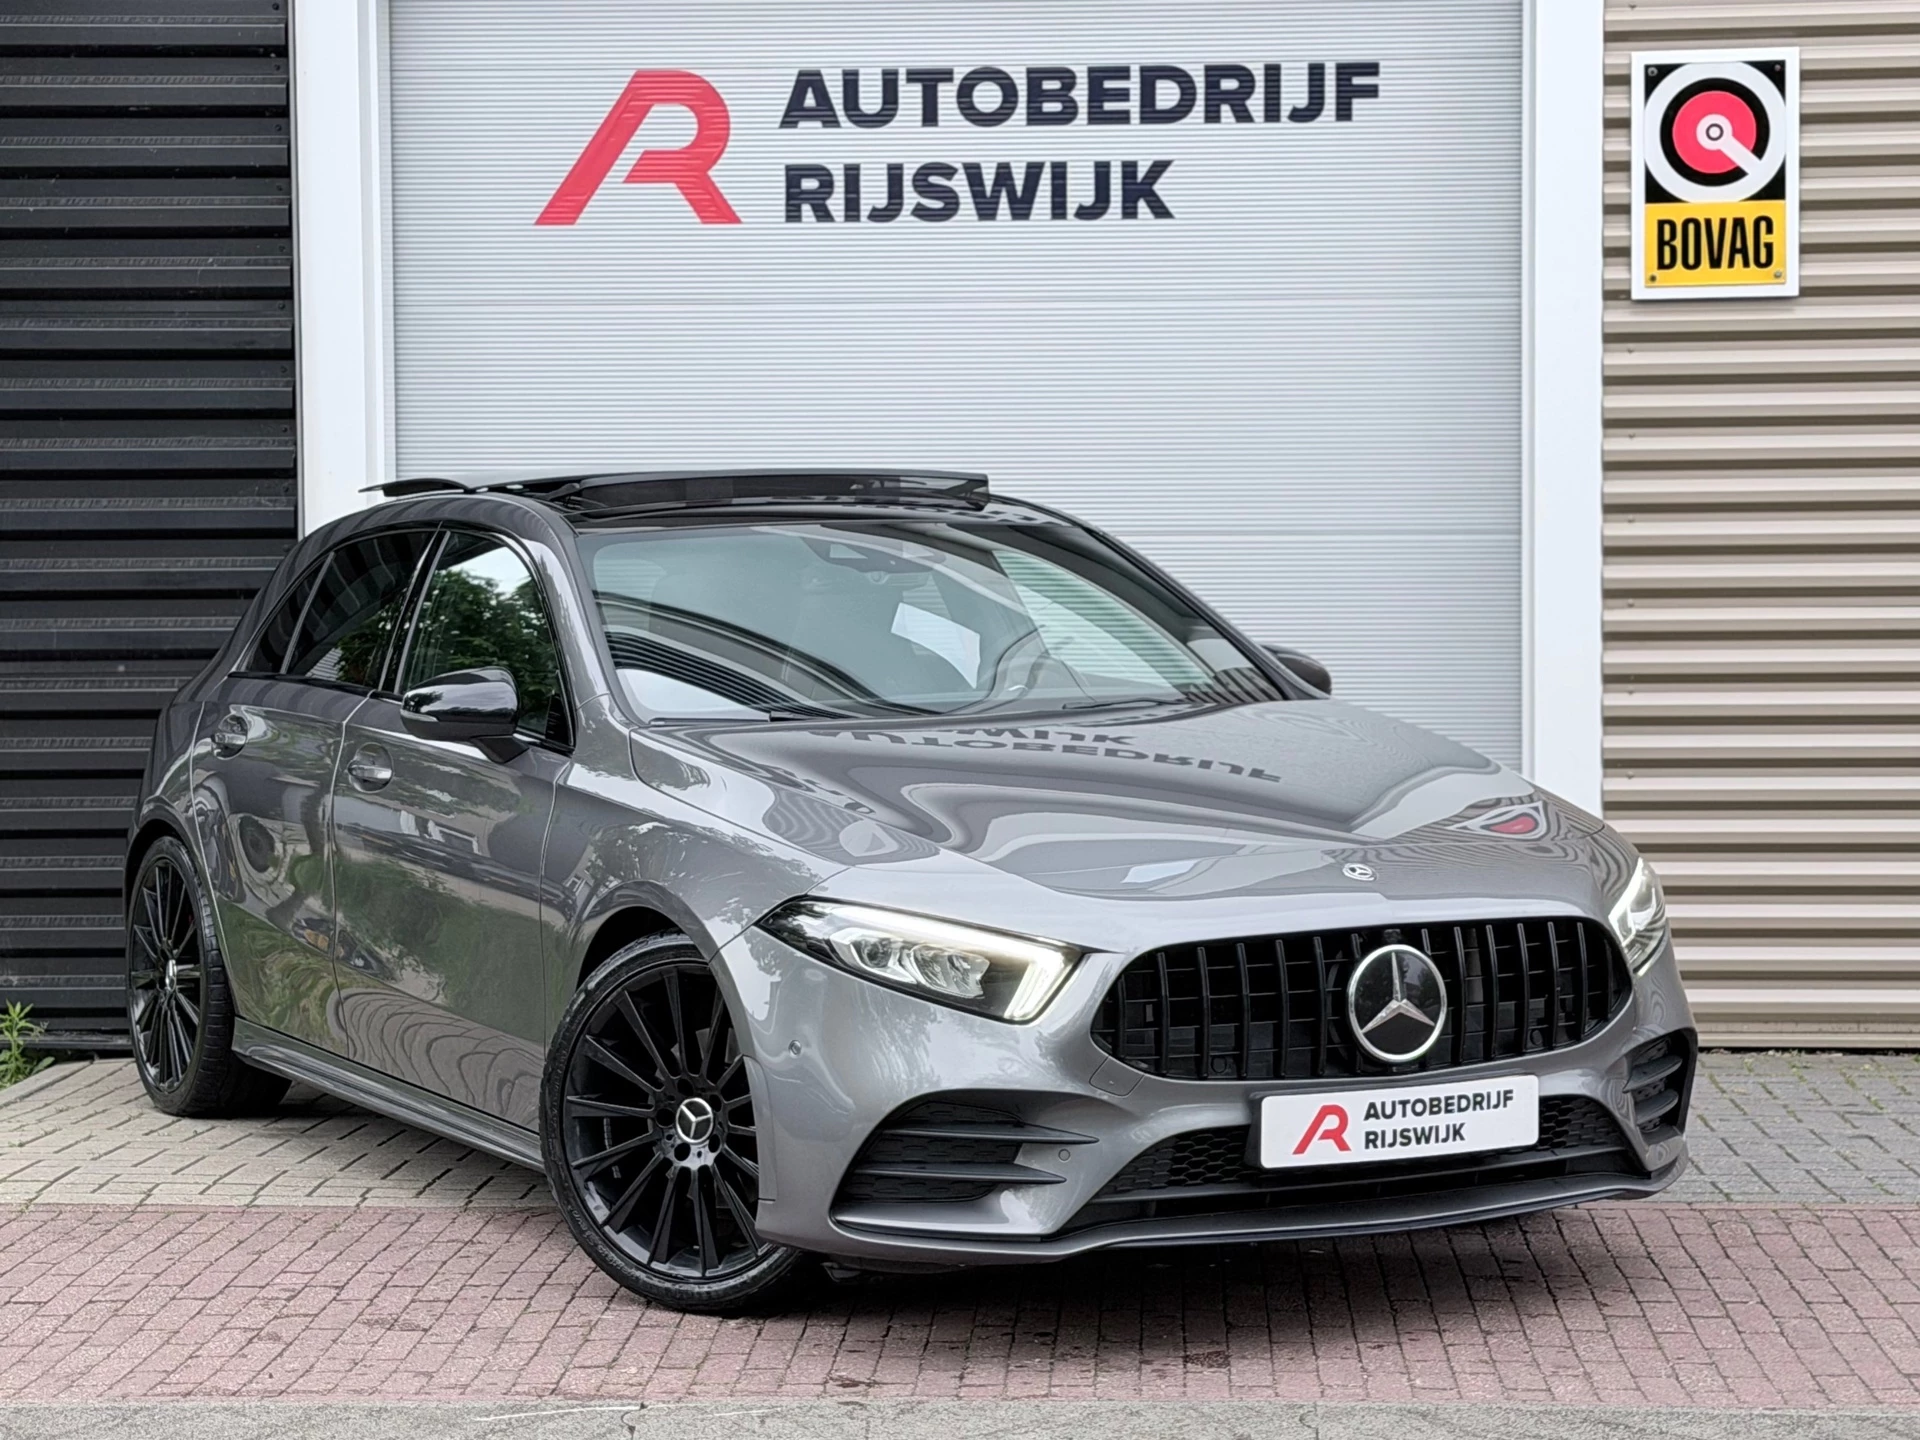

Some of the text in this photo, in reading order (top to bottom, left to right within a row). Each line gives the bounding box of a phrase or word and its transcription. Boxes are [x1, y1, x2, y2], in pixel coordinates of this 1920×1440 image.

[778, 62, 1381, 129] AUTOBEDRIJF
[784, 159, 1176, 224] RIJSWIJK
[1656, 215, 1774, 271] BOVAG
[1363, 1089, 1514, 1121] AUTOBEDRIJF
[1363, 1122, 1467, 1150] RIJSWIJK
